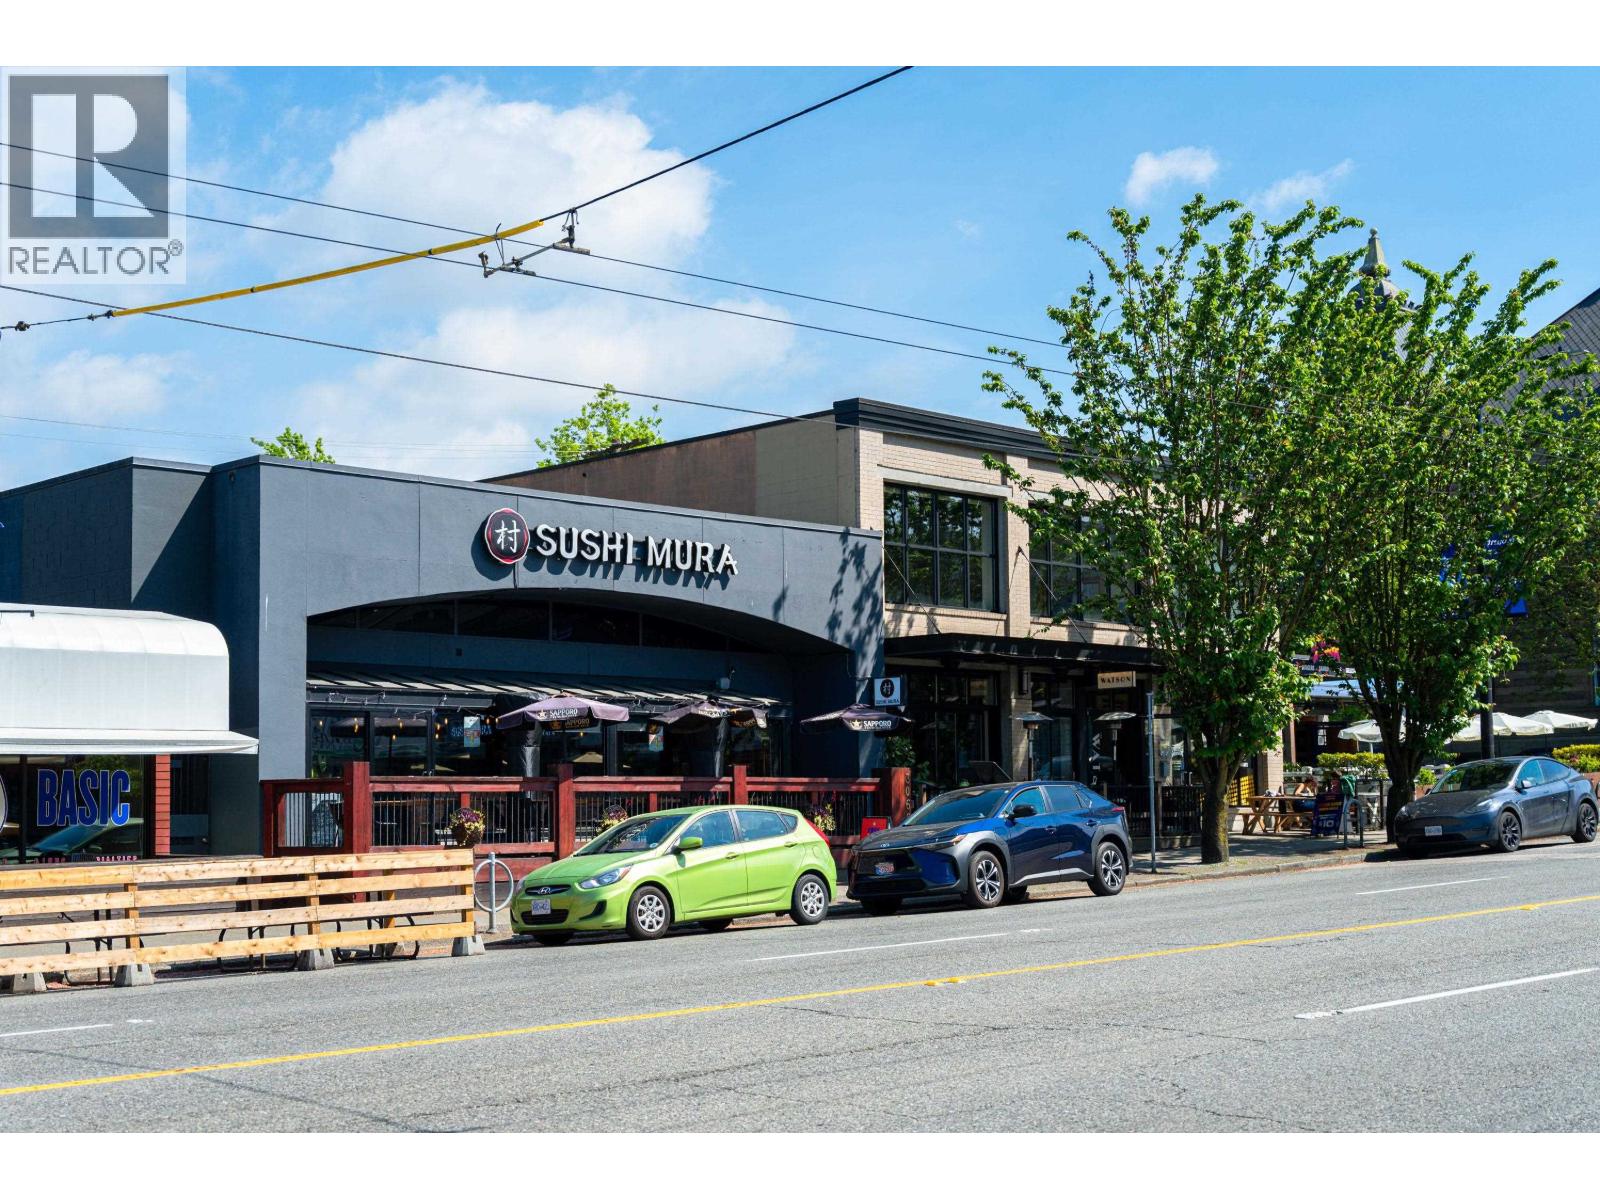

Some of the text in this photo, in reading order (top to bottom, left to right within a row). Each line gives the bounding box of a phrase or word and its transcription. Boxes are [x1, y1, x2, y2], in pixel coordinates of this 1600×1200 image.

[494, 519, 521, 554] 村
[536, 523, 739, 575] SUSHI MURA
[1100, 676, 1131, 684] WATSON
[549, 708, 578, 717] SAPPORO
[37, 768, 131, 827] BASIC
